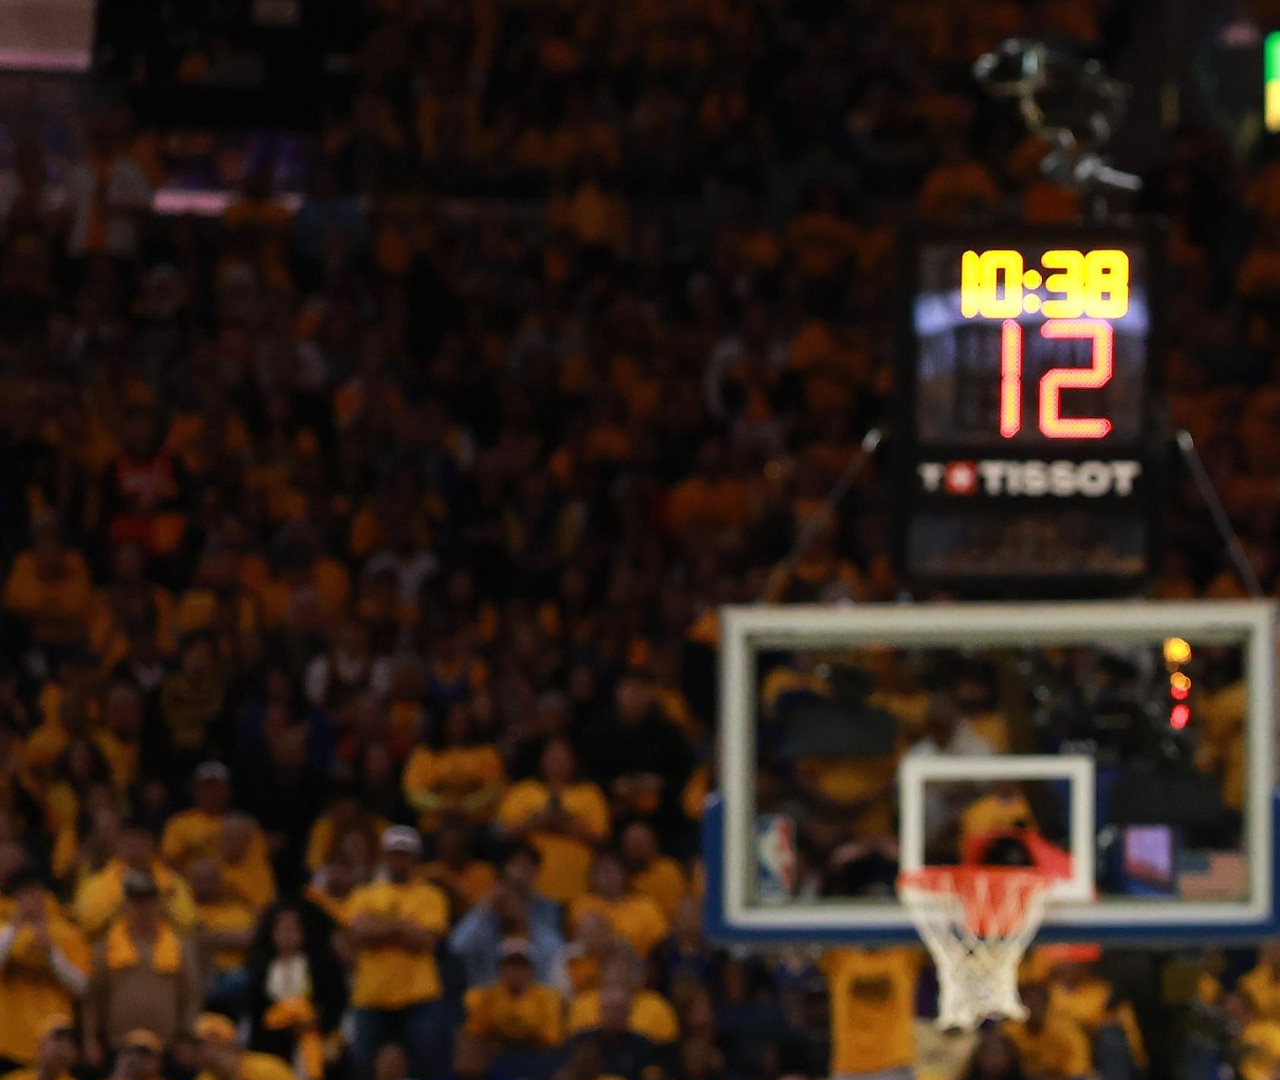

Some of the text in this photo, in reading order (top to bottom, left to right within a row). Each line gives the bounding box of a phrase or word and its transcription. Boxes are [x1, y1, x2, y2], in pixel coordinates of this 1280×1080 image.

[961, 250, 1129, 319] 10:38
[1000, 318, 1114, 439] 12
[979, 460, 1142, 496] TISSOT
